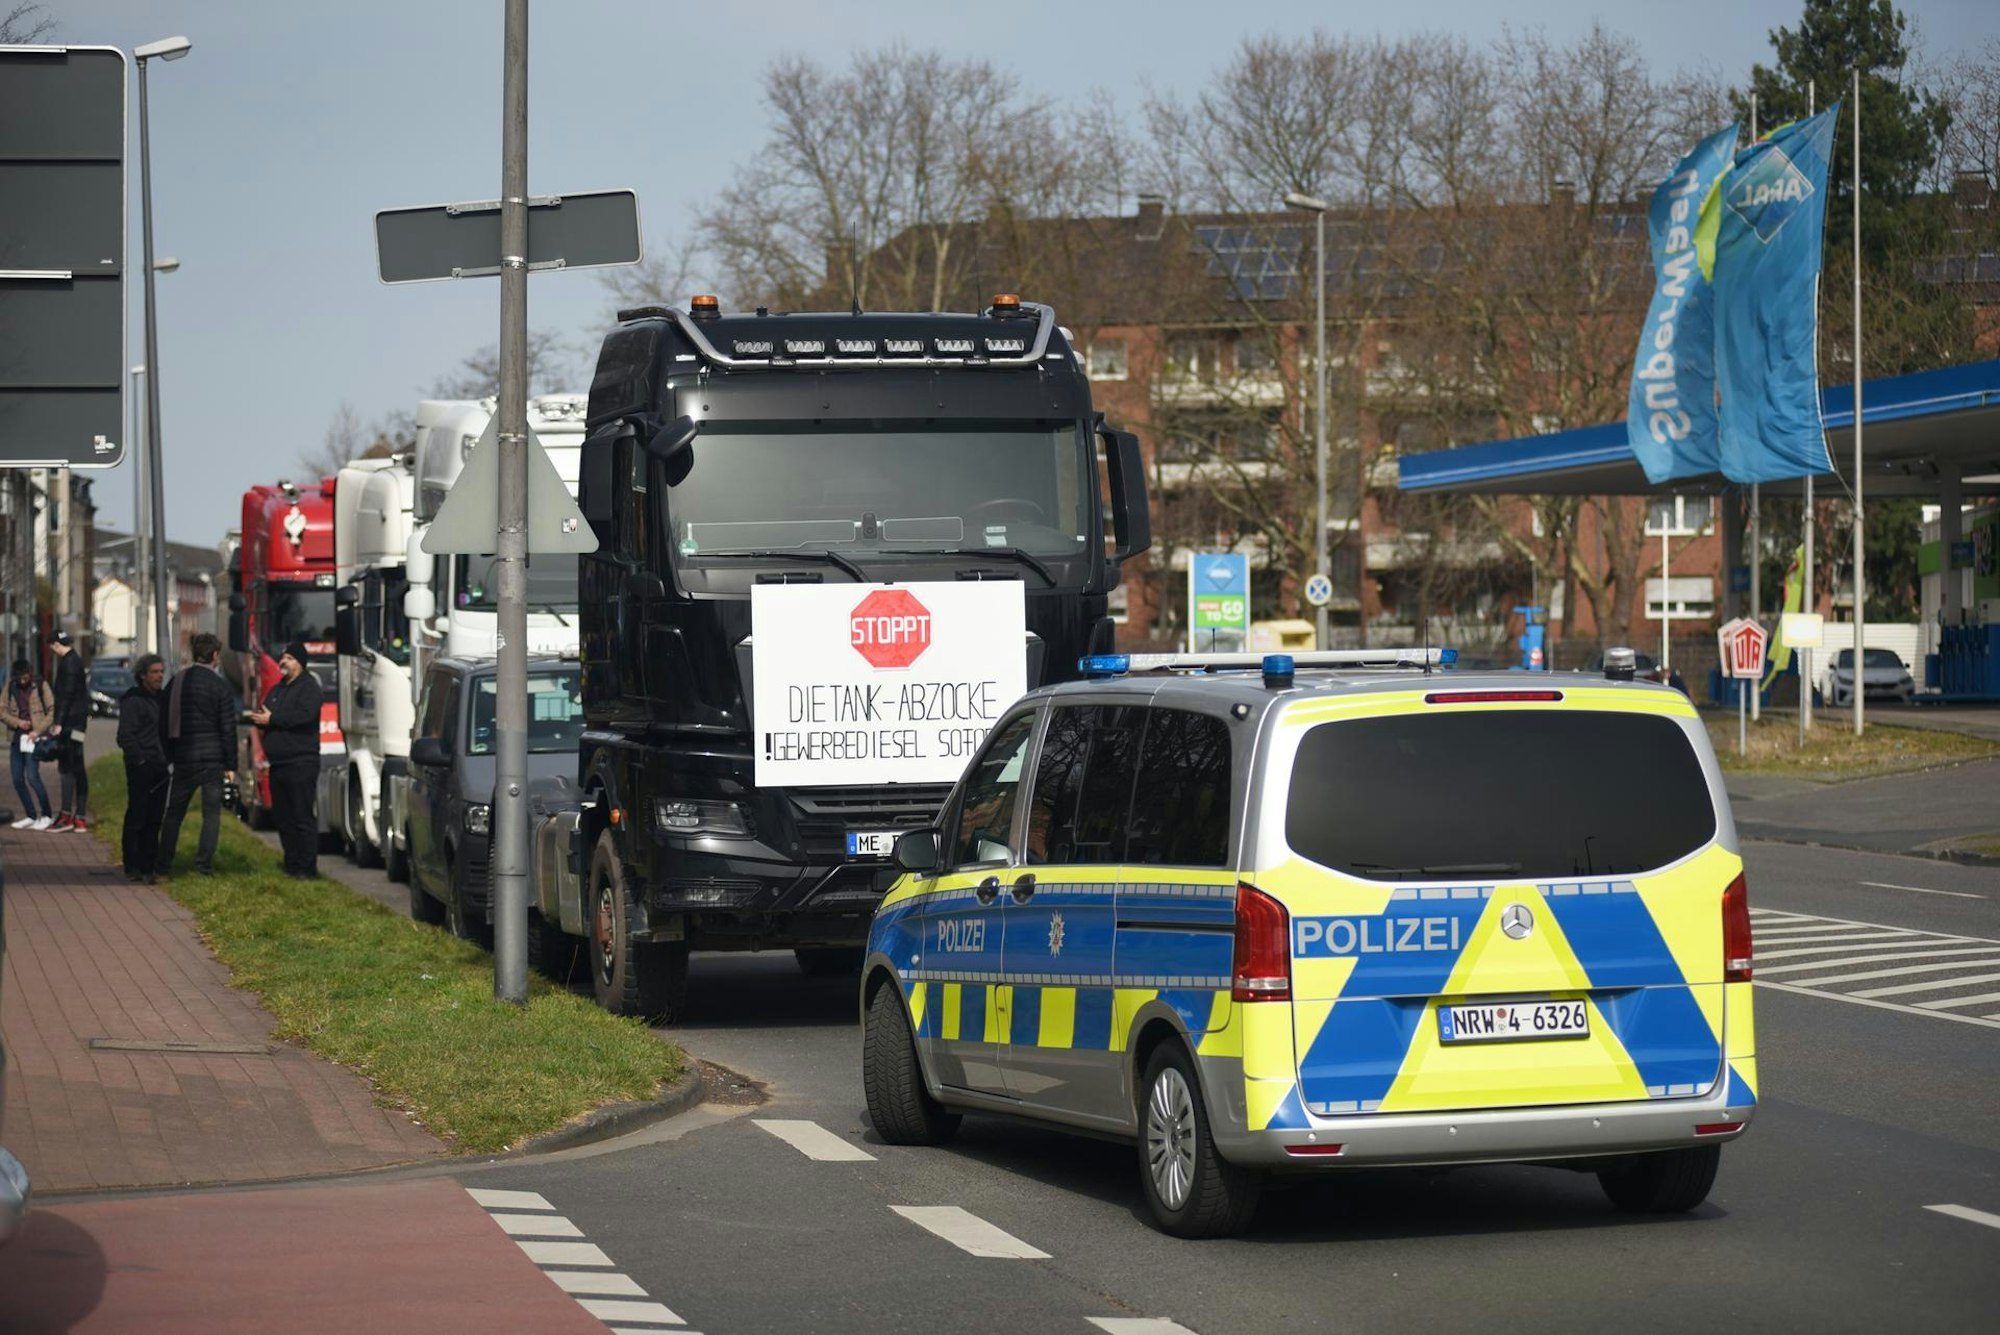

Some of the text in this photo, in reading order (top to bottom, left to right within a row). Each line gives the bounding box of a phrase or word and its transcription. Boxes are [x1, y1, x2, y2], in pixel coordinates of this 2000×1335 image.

[851, 615, 931, 645] STOPPT
[789, 685, 826, 722] DIE
[859, 835, 880, 851] ME
[937, 919, 986, 952] POLIZEI
[1297, 916, 1459, 955] POLIZEI
[1453, 1004, 1585, 1035] NRW 4-6326
